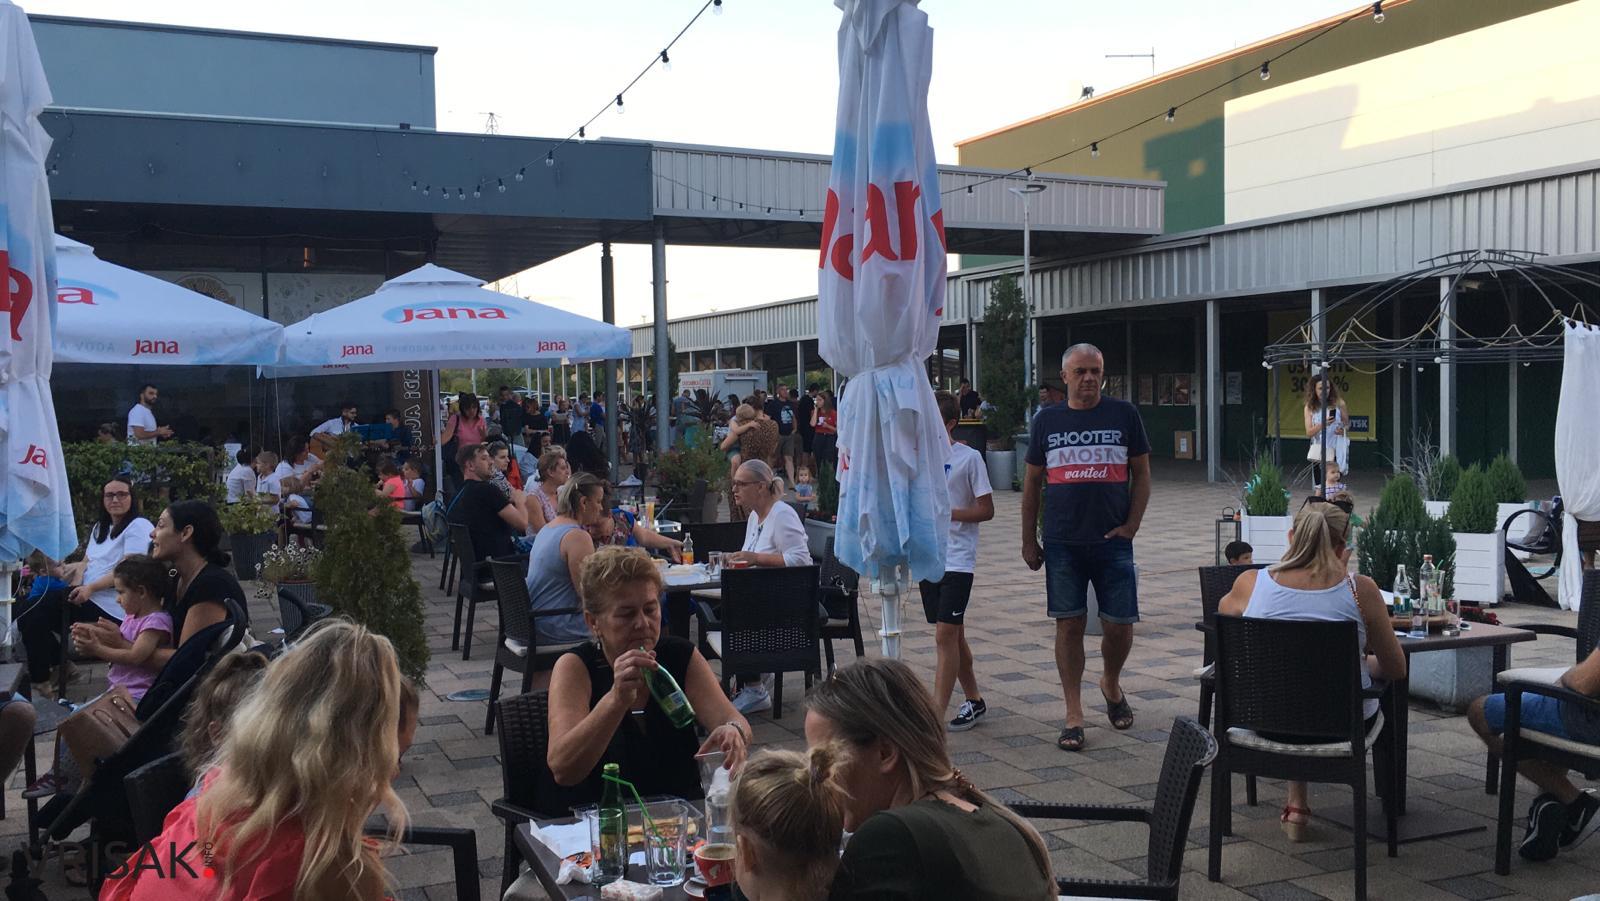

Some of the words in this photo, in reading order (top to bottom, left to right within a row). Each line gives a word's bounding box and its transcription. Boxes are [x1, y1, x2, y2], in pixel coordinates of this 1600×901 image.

[1047, 429, 1122, 448] SHOOTER
[1058, 447, 1114, 465] MOST
[1064, 466, 1108, 480] wanted
